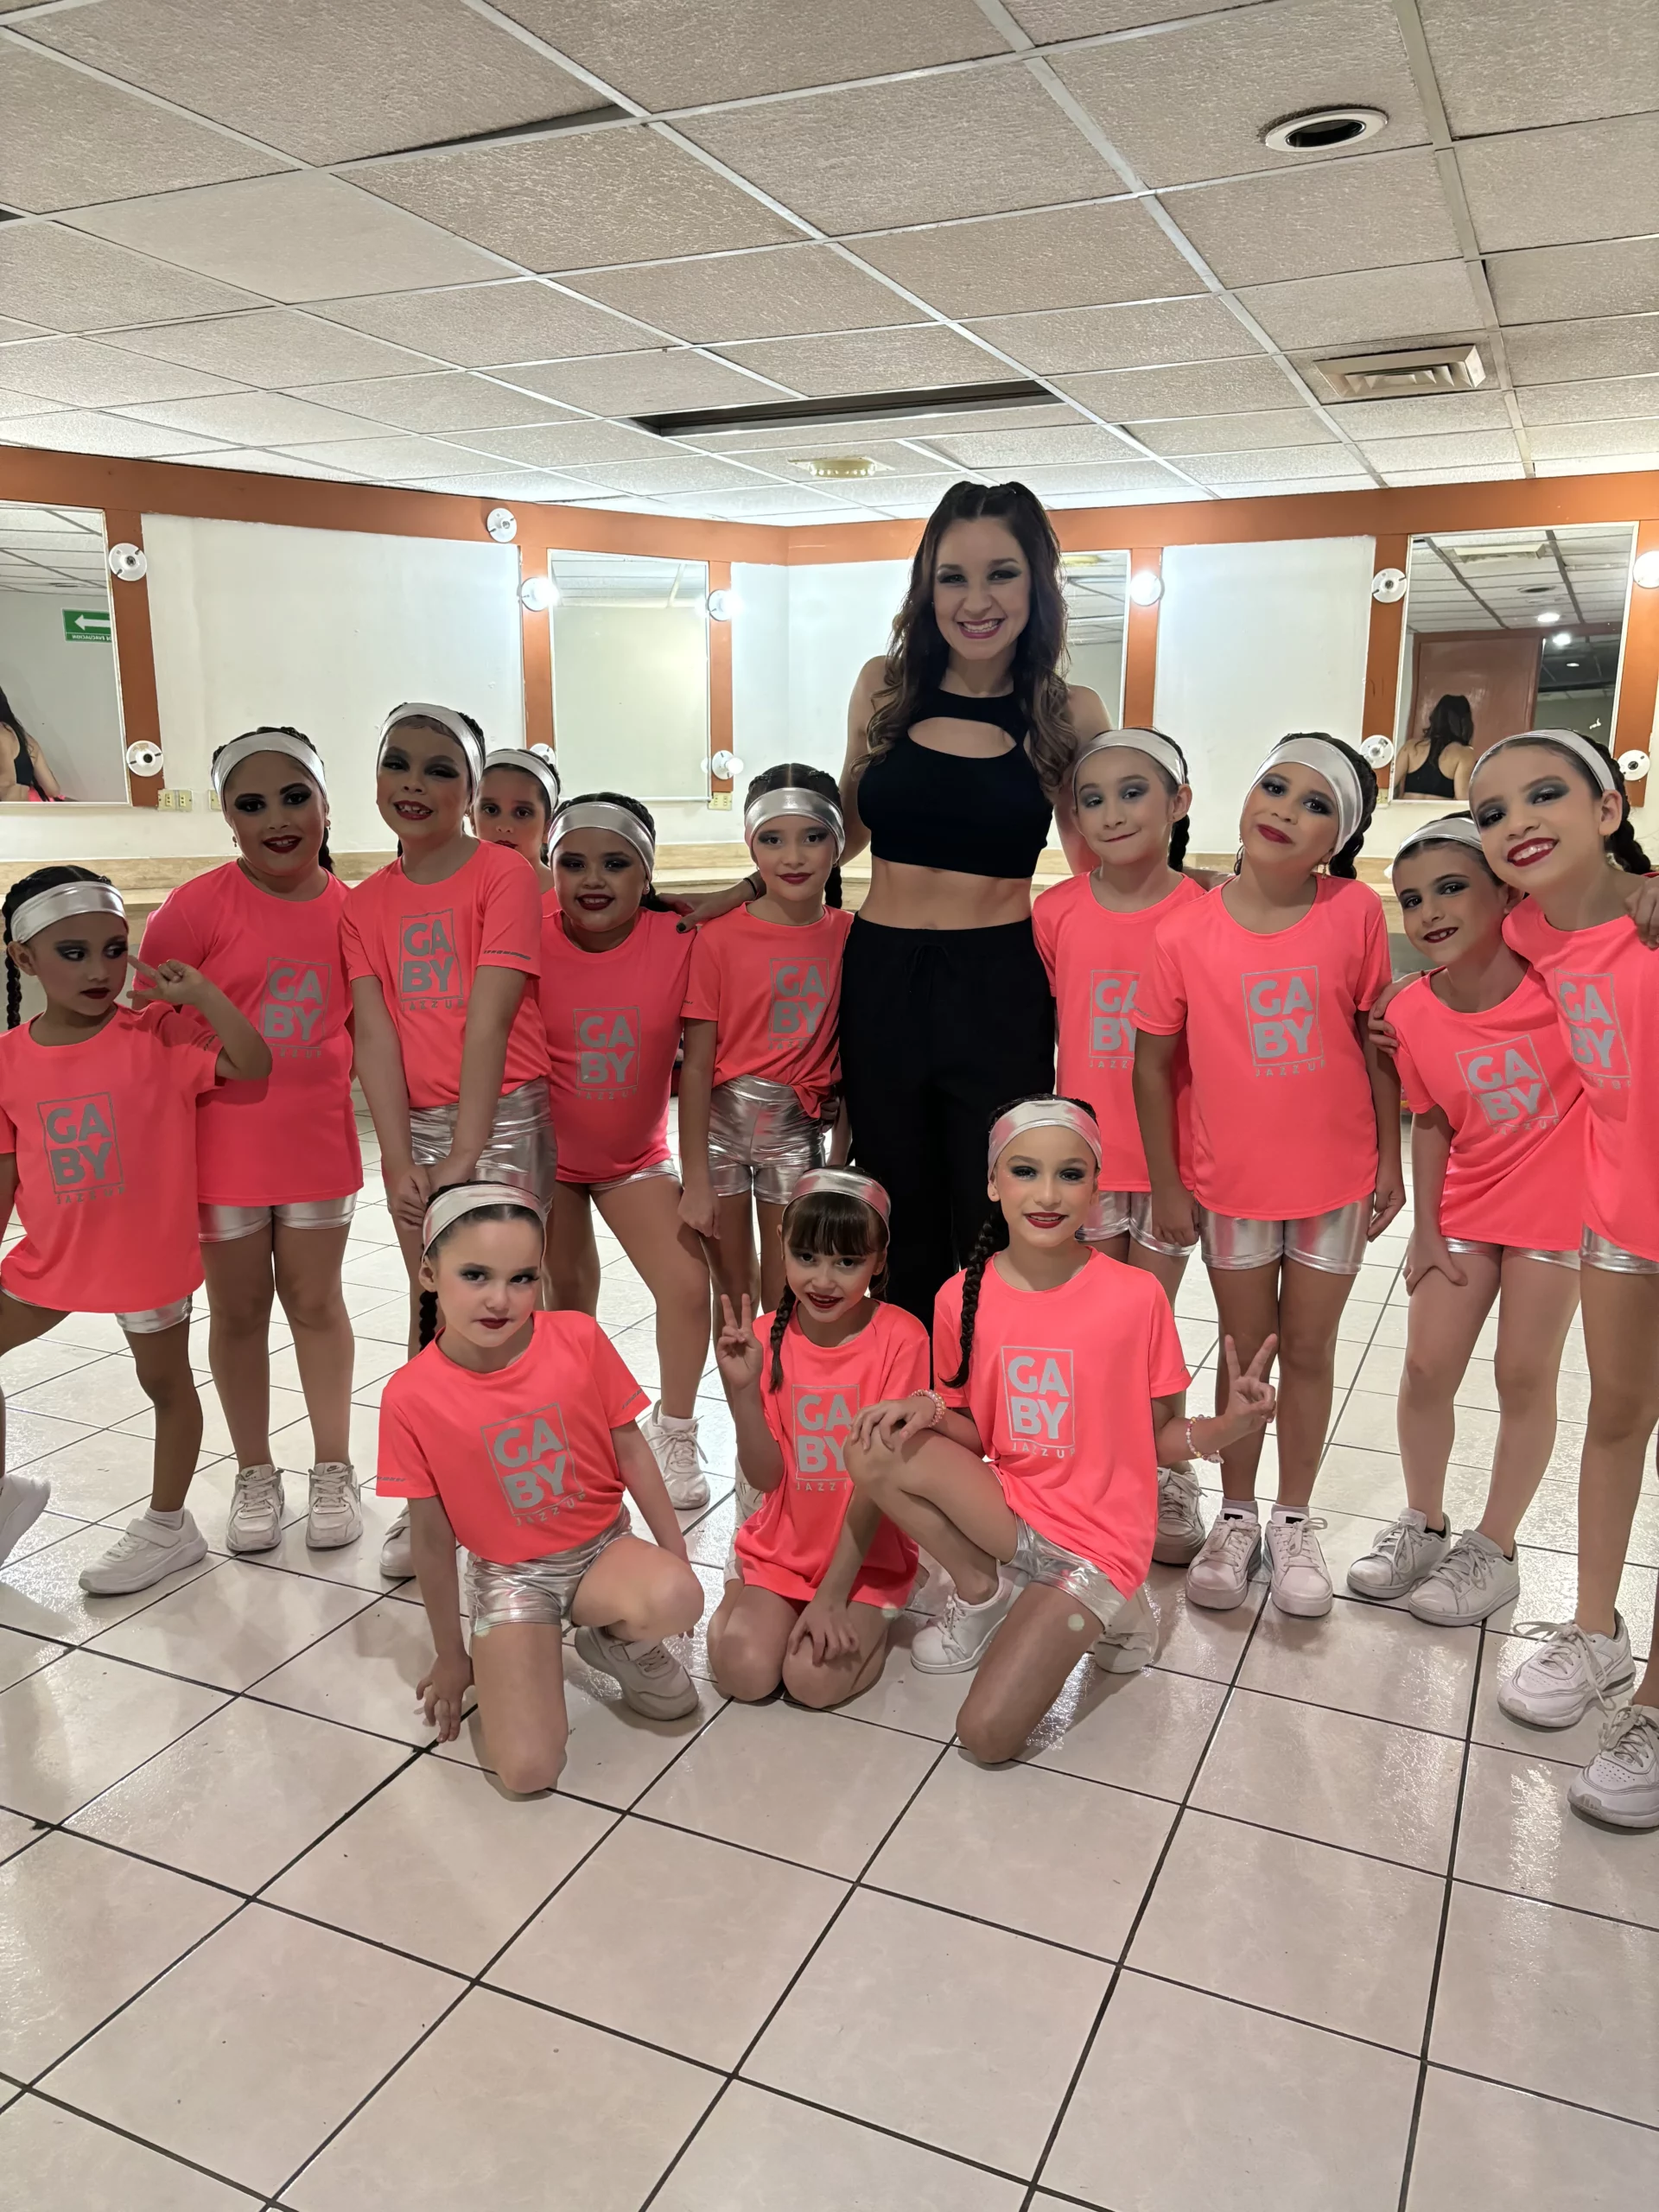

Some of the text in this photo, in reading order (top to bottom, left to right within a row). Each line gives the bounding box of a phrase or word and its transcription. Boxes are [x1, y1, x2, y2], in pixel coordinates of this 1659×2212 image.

[404, 919, 452, 957] GA
[269, 966, 323, 1006] GA
[403, 957, 454, 993] BY
[775, 964, 827, 998] GA
[1249, 976, 1314, 1016] GA
[1560, 981, 1614, 1026] GA
[264, 1003, 322, 1042] BY
[579, 1014, 635, 1049] GA
[772, 1001, 825, 1034] BY
[1253, 1014, 1314, 1058] BY
[1569, 1022, 1617, 1069] BY
[580, 1050, 636, 1084] BY
[1467, 1048, 1540, 1090] GA
[1478, 1083, 1542, 1121] BY
[46, 1103, 111, 1144] GA
[49, 1141, 112, 1185] BY
[1007, 1355, 1070, 1397] GA
[797, 1394, 853, 1432] GA
[1010, 1395, 1070, 1440] BY
[493, 1417, 564, 1468] GA
[502, 1453, 566, 1509] BY
